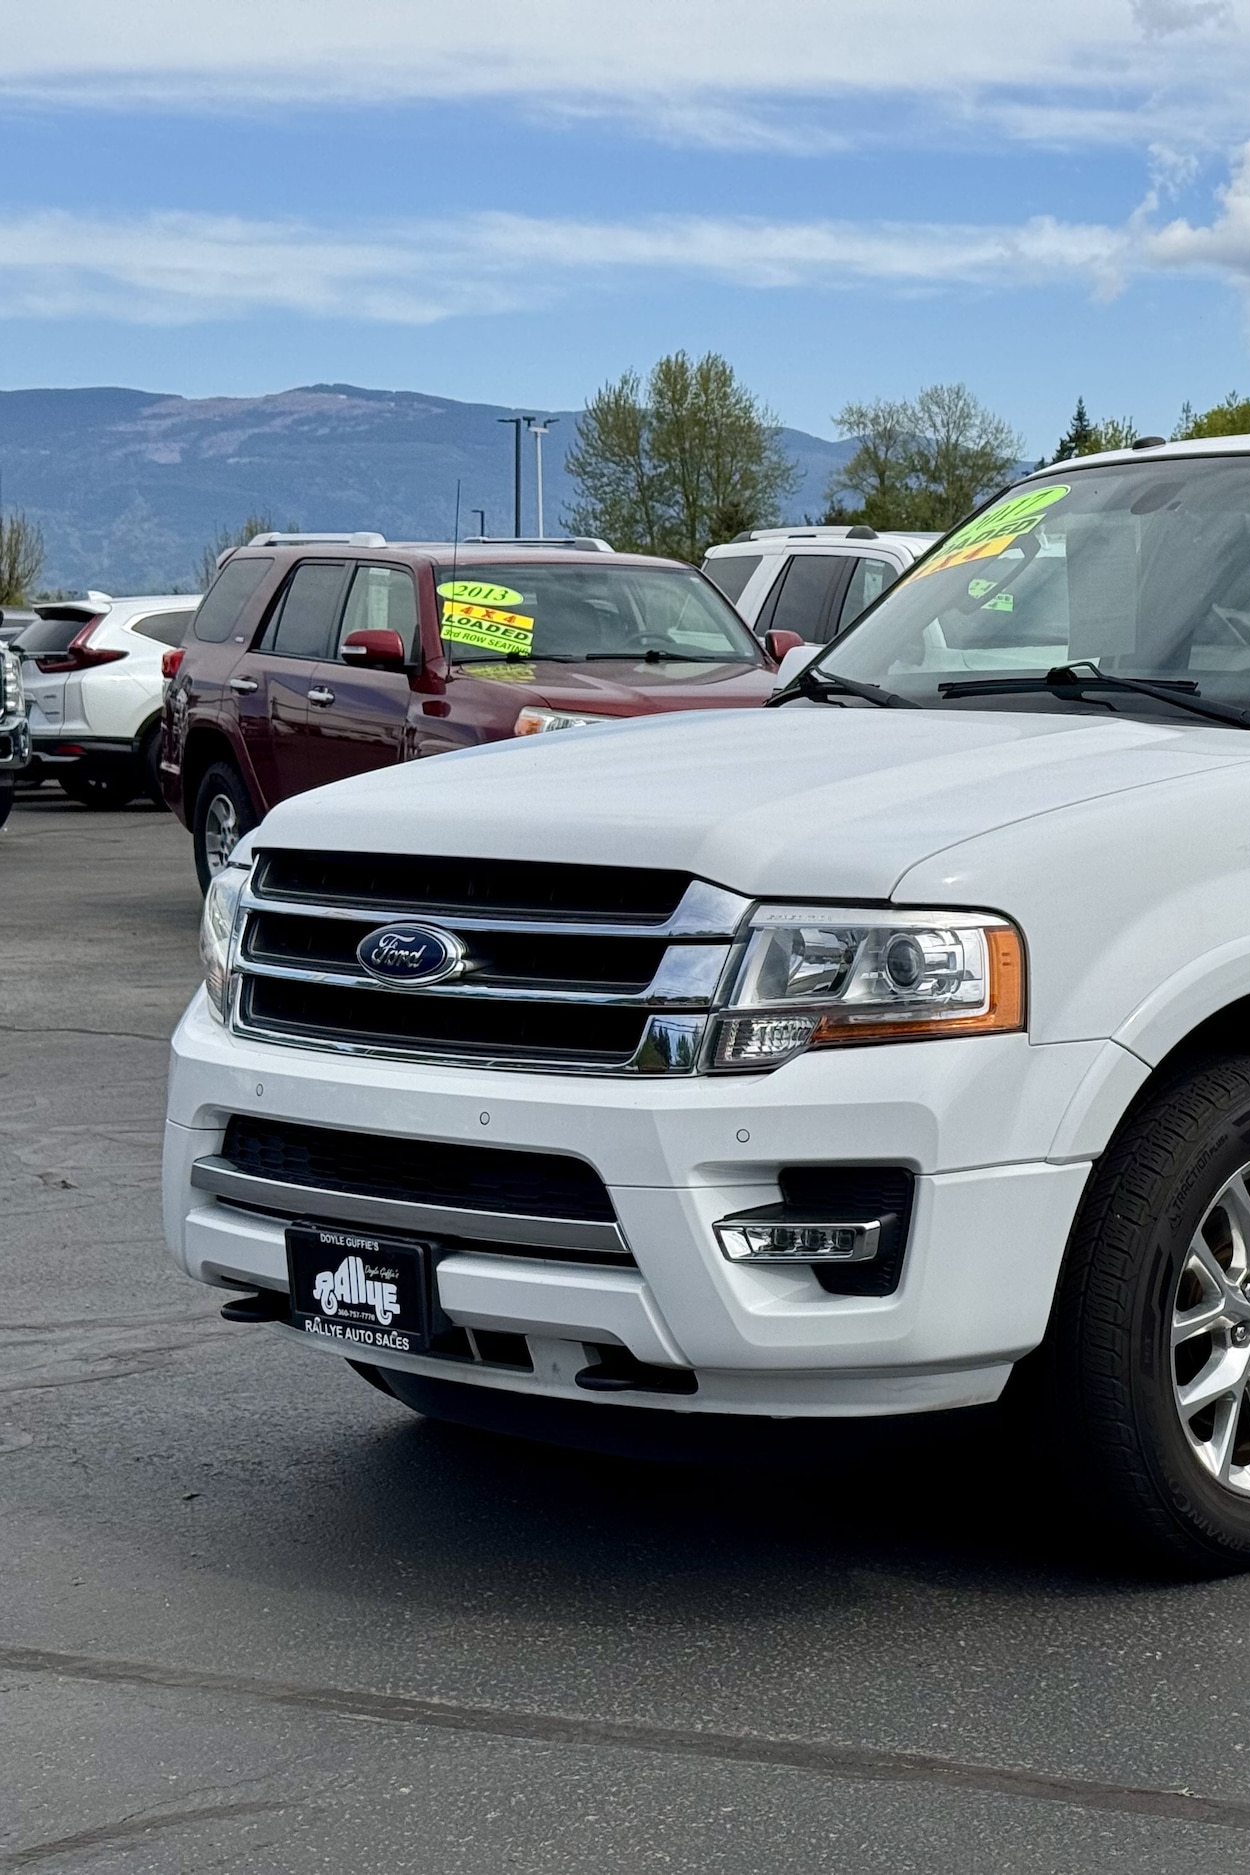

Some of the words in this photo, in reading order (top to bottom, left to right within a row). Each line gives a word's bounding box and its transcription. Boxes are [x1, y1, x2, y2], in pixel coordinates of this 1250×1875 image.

[454, 585, 509, 601] 2013
[445, 614, 530, 641] LOADED
[462, 632, 487, 644] ROW
[371, 933, 428, 968] Ford
[320, 1233, 345, 1246] DOYLE
[346, 1237, 379, 1251] GUFFIE'S
[305, 1319, 344, 1338] RALLYE
[345, 1329, 374, 1344] AUTO
[375, 1333, 410, 1351] SALES
